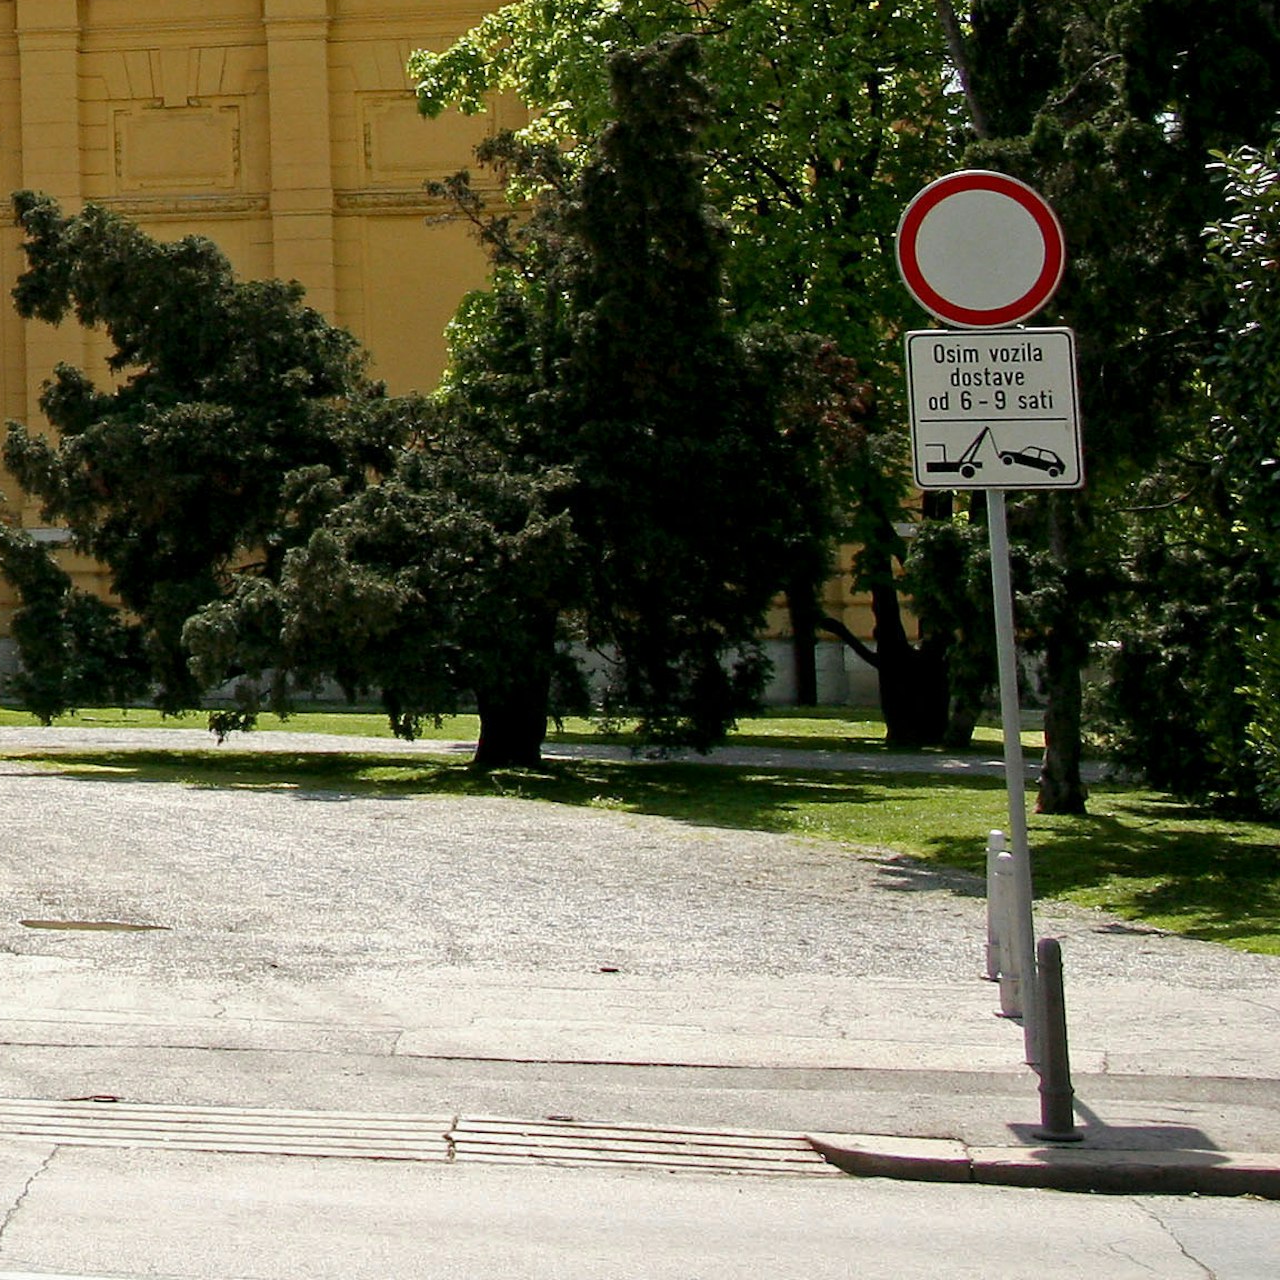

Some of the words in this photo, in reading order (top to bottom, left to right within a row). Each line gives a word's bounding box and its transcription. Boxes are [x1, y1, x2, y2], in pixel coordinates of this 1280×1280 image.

[933, 343, 980, 364] Osim
[989, 342, 1044, 363] vozila
[950, 367, 1026, 387] dostave
[928, 391, 950, 411] od
[960, 390, 973, 411] 6
[994, 389, 1007, 410] 9
[1018, 389, 1054, 410] sati
